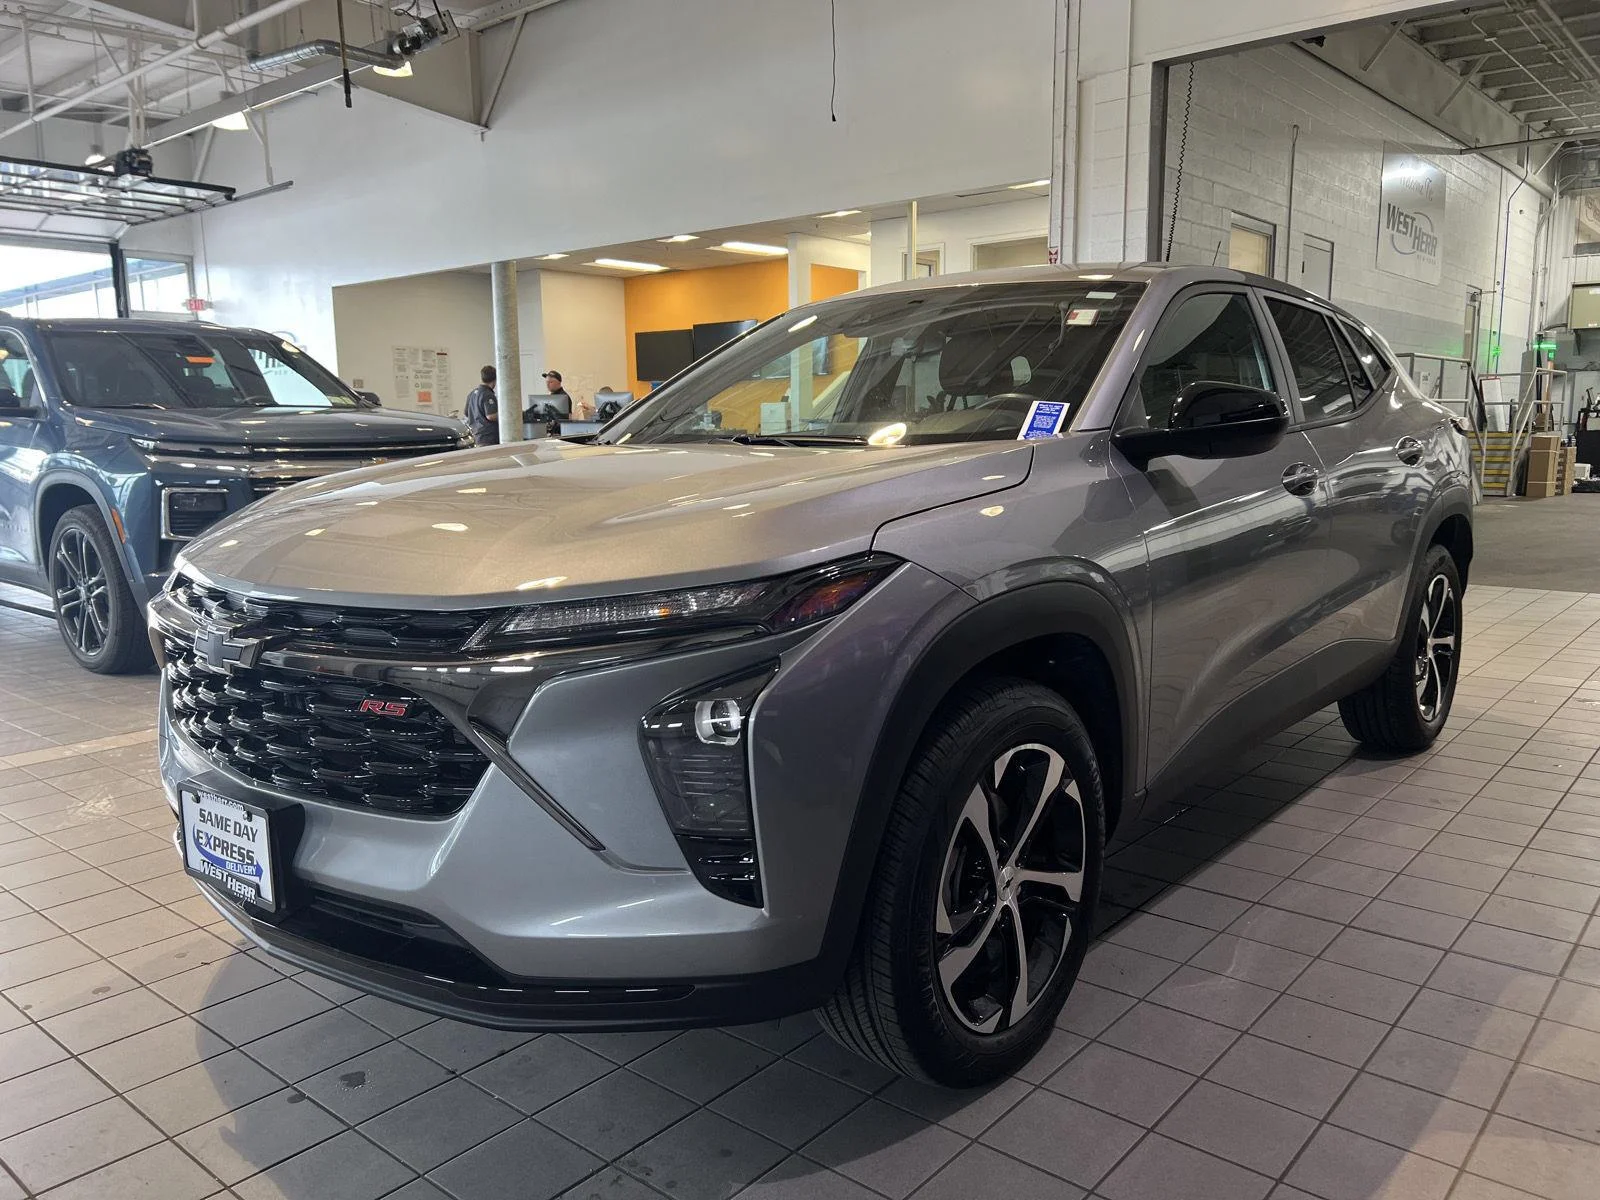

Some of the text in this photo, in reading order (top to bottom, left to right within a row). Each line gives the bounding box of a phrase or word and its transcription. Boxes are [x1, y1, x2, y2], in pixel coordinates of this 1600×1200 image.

[1386, 203, 1437, 257] WEST HERR
[360, 699, 408, 716] RS
[199, 808, 258, 843] SAME DAY
[196, 828, 255, 865] EXPRESS
[200, 859, 229, 882] WEST
[227, 876, 256, 900] HERR
[225, 860, 257, 876] DELIVERY
